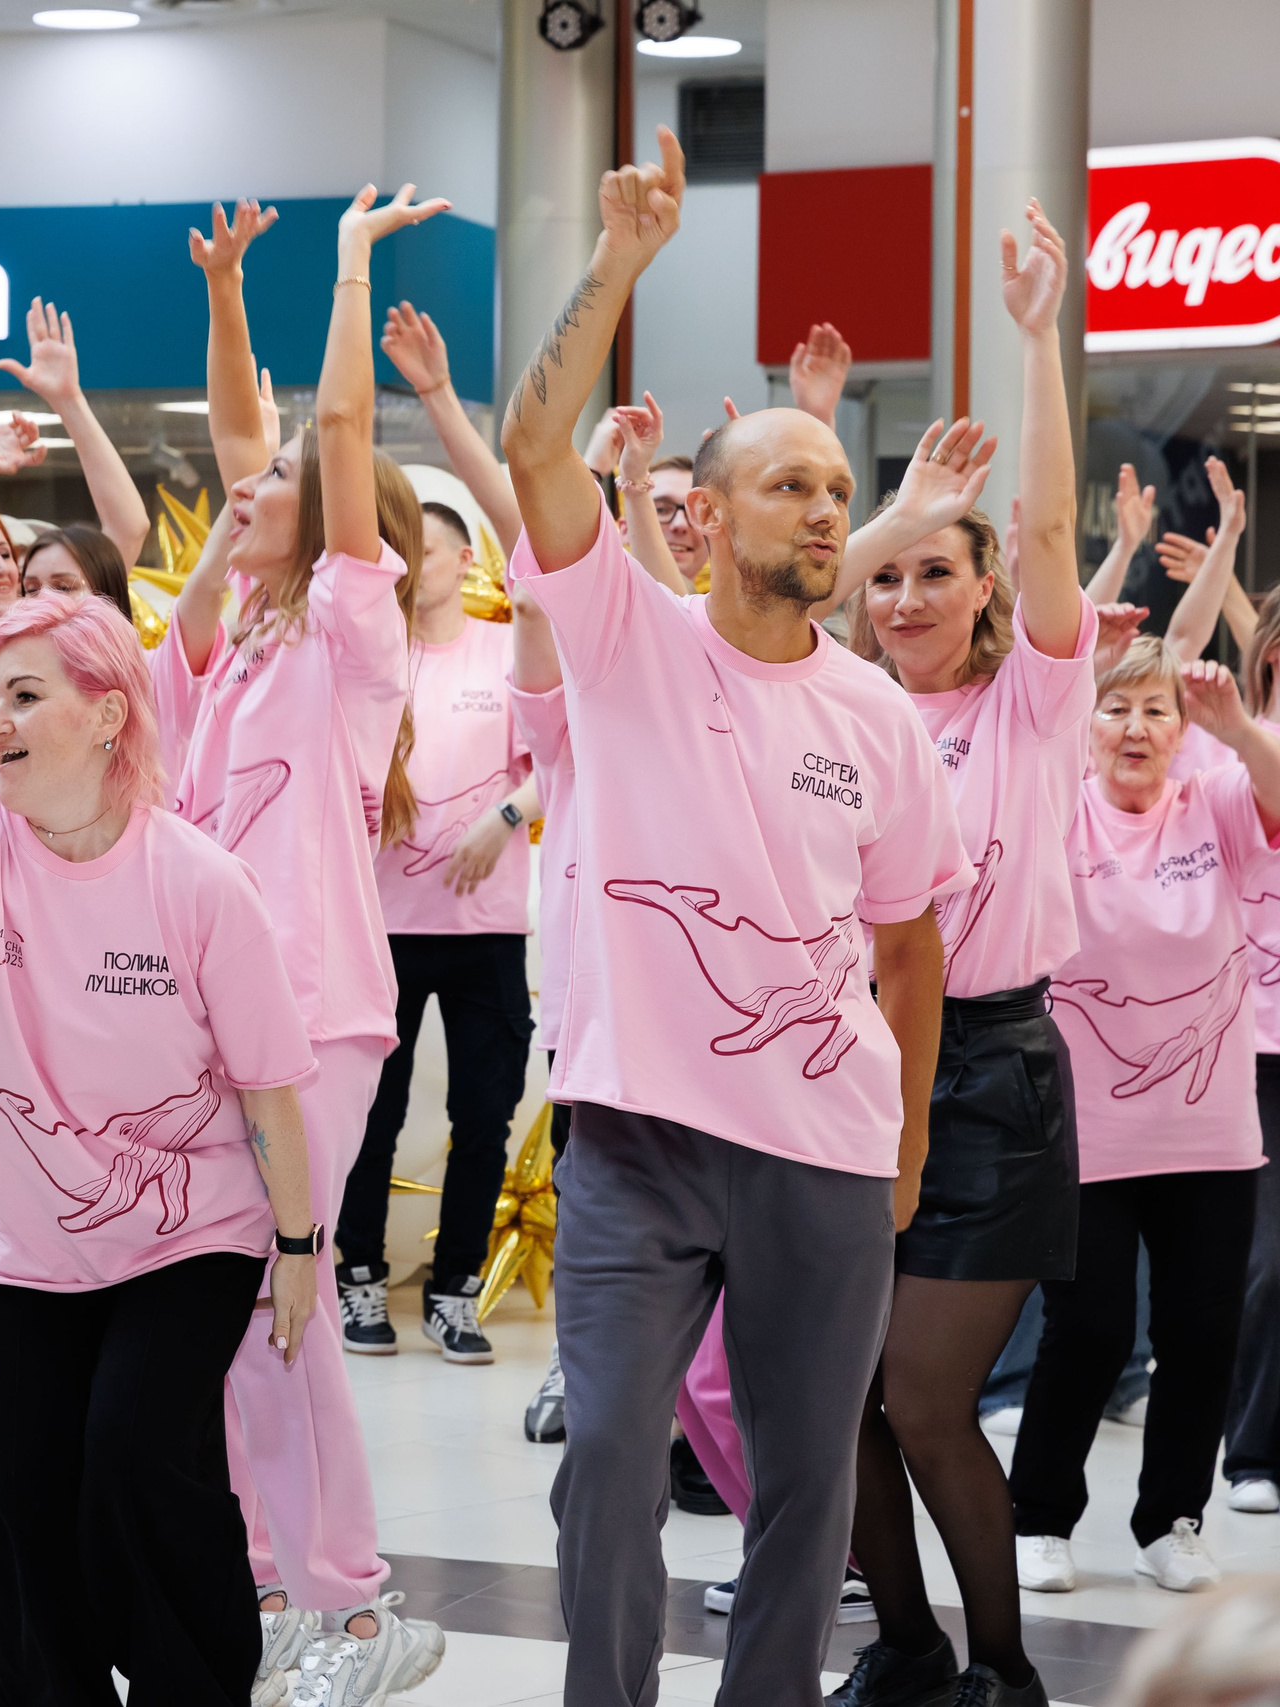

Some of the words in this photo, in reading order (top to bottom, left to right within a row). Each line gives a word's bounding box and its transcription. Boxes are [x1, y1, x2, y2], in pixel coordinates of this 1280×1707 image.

[802, 752, 859, 785] СЕРГЕЙ
[941, 753, 960, 770] ЯН
[791, 771, 863, 810] БУЛДАКОВ
[104, 951, 170, 973] ПОЛИНА
[85, 974, 180, 996] ЛУЩЕНКОВ
